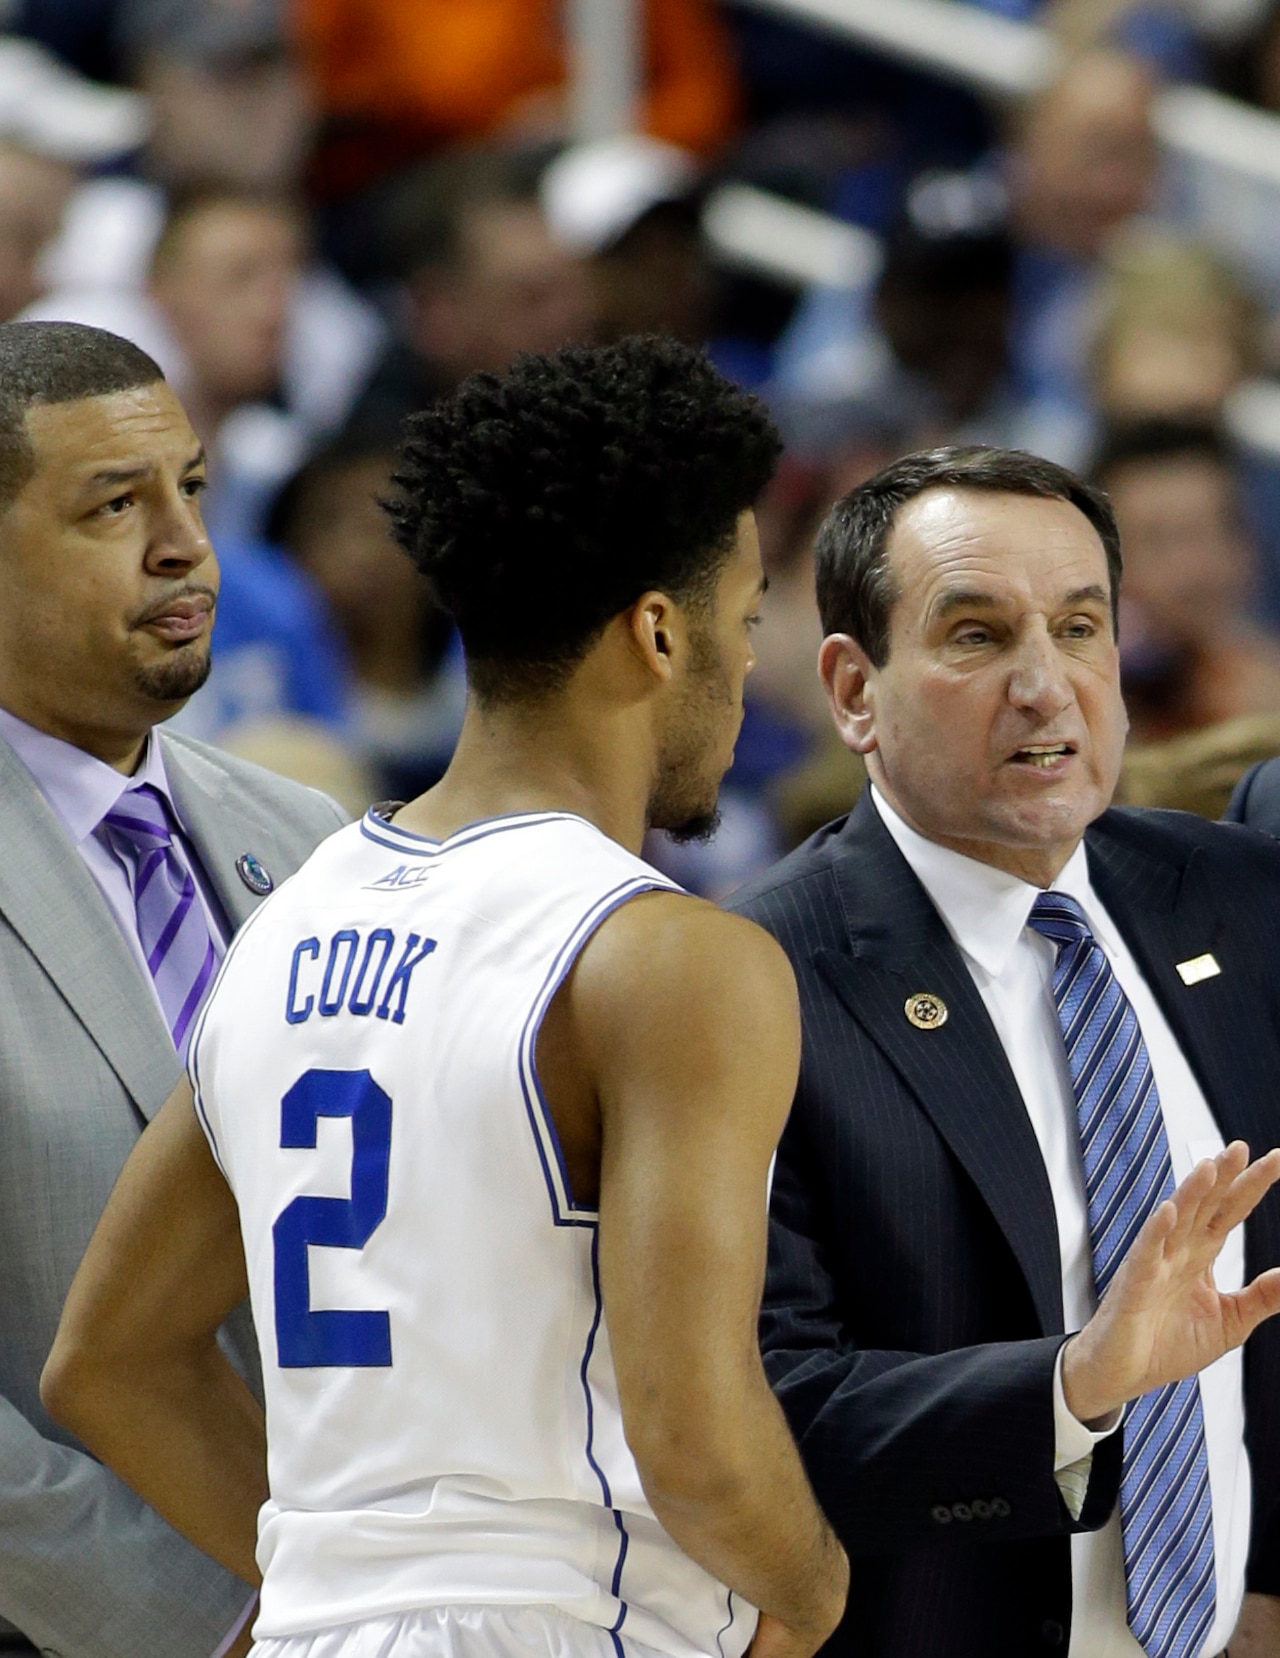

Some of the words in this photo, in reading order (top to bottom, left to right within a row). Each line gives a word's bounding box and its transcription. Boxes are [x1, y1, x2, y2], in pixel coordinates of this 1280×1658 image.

[371, 864, 442, 887] ACC
[286, 928, 438, 1026] COOK
[273, 1068, 393, 1368] 2
